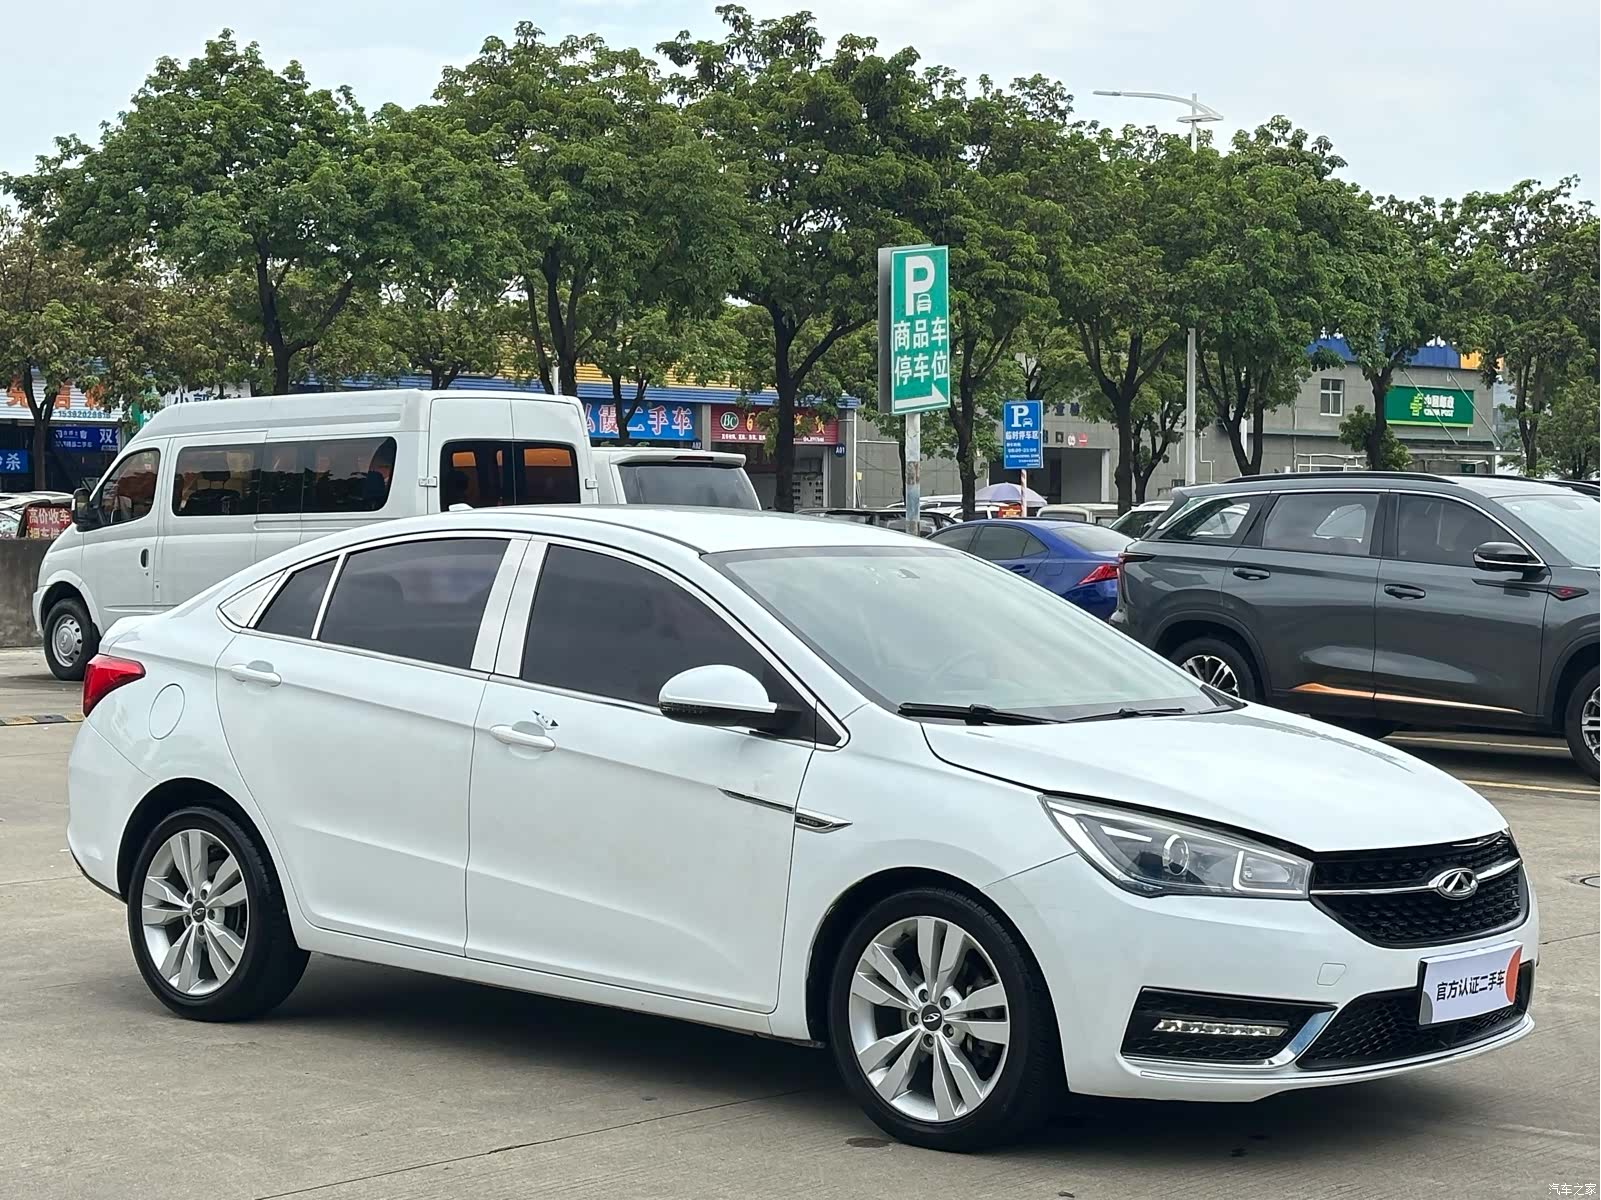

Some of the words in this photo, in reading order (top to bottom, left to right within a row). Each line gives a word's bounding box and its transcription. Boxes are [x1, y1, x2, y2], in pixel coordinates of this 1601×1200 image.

[905, 256, 935, 316] P
[894, 317, 947, 351] 商品车
[895, 352, 948, 386] 停车位
[1011, 405, 1029, 427] P
[1005, 430, 1039, 440] 临时停车区
[27, 508, 71, 525] 高价收车
[1436, 970, 1506, 1001] 官方认证二手车
